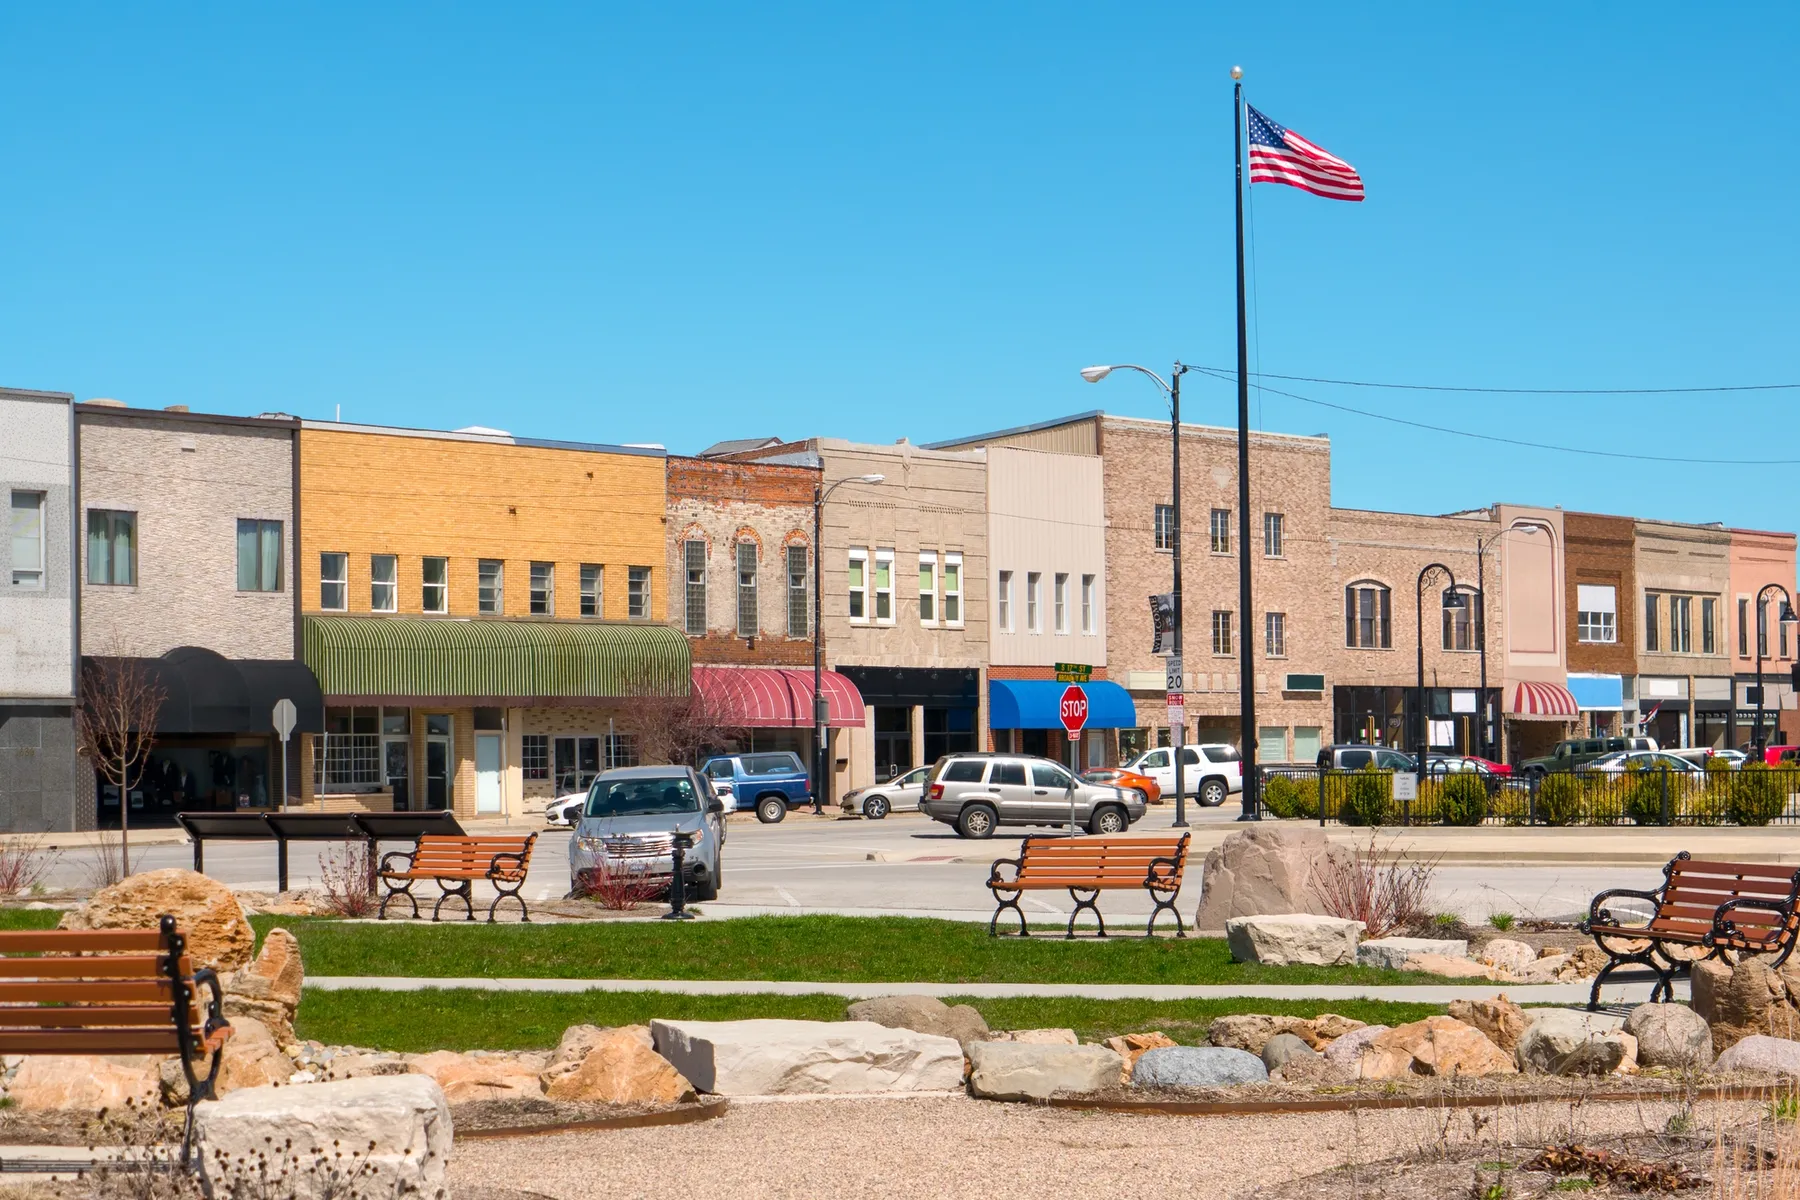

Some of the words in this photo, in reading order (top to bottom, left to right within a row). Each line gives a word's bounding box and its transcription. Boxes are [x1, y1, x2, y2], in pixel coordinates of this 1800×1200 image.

[1150, 596, 1162, 652] WELCOME
[1168, 675, 1182, 689] 20
[1062, 700, 1086, 717] STOP
